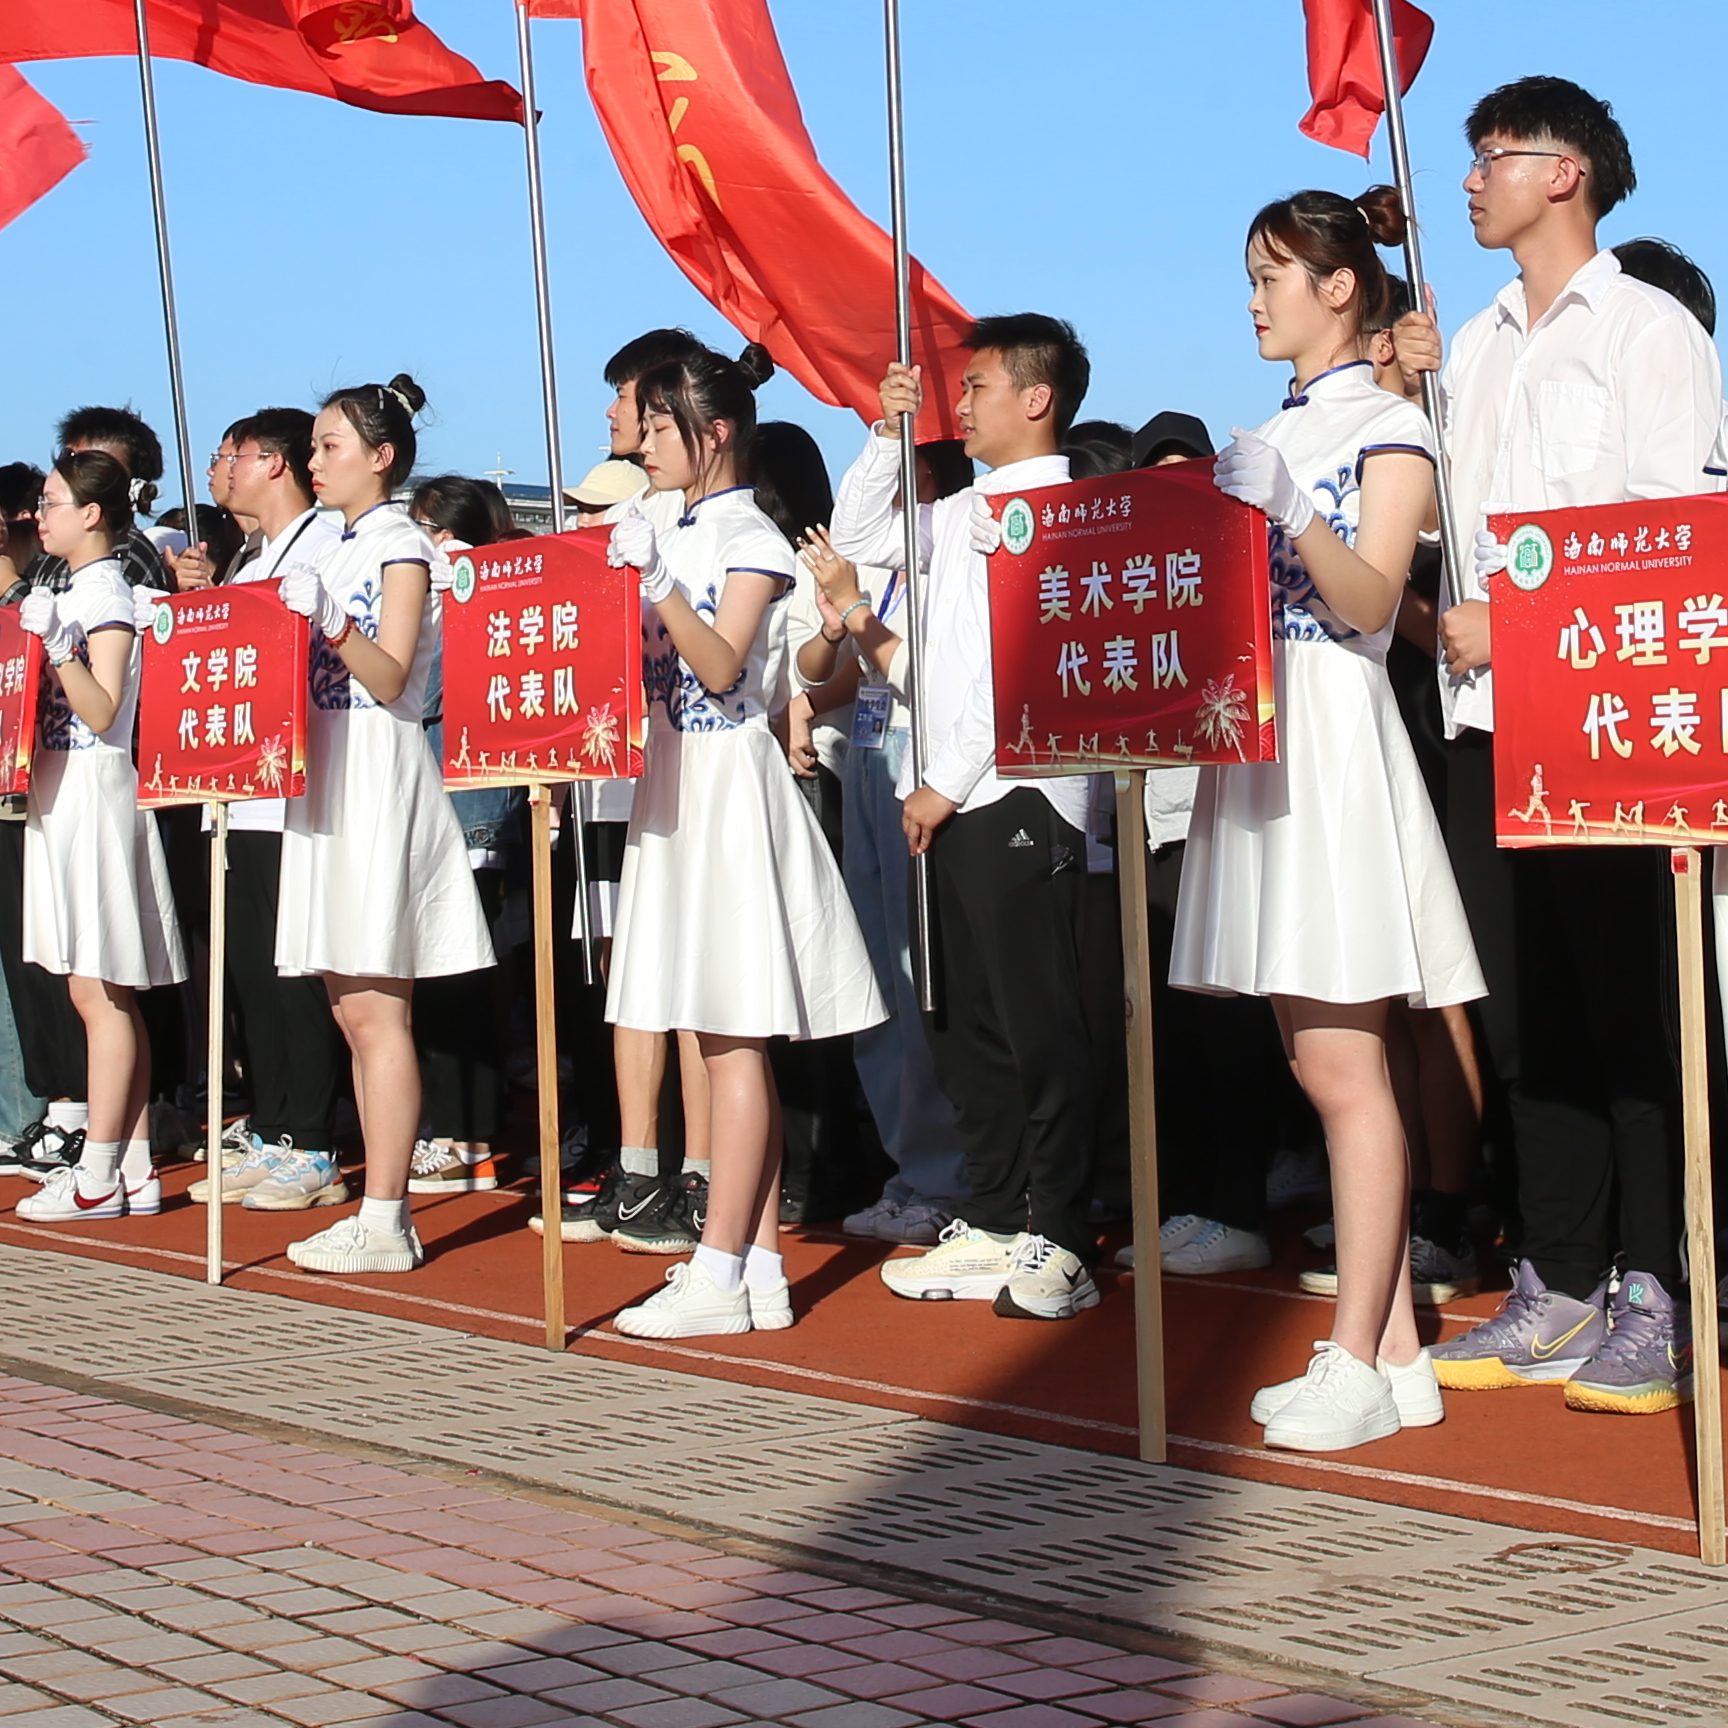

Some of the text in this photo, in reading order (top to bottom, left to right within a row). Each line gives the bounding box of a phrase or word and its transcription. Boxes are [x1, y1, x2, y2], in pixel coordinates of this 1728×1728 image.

[1041, 495, 1132, 528] 海南师范大学
[1563, 524, 1693, 560] 海南师范大学
[1564, 555, 1694, 576] HAINAN NORMAL UNIVERSITY
[480, 555, 543, 581] 海南师范大学
[1038, 548, 1204, 625] 美术学院
[486, 601, 579, 659] 法学院
[180, 644, 258, 695] 文学院
[1056, 630, 1189, 698] 代表队
[485, 666, 579, 723] 代表队
[178, 701, 255, 751] 代表队
